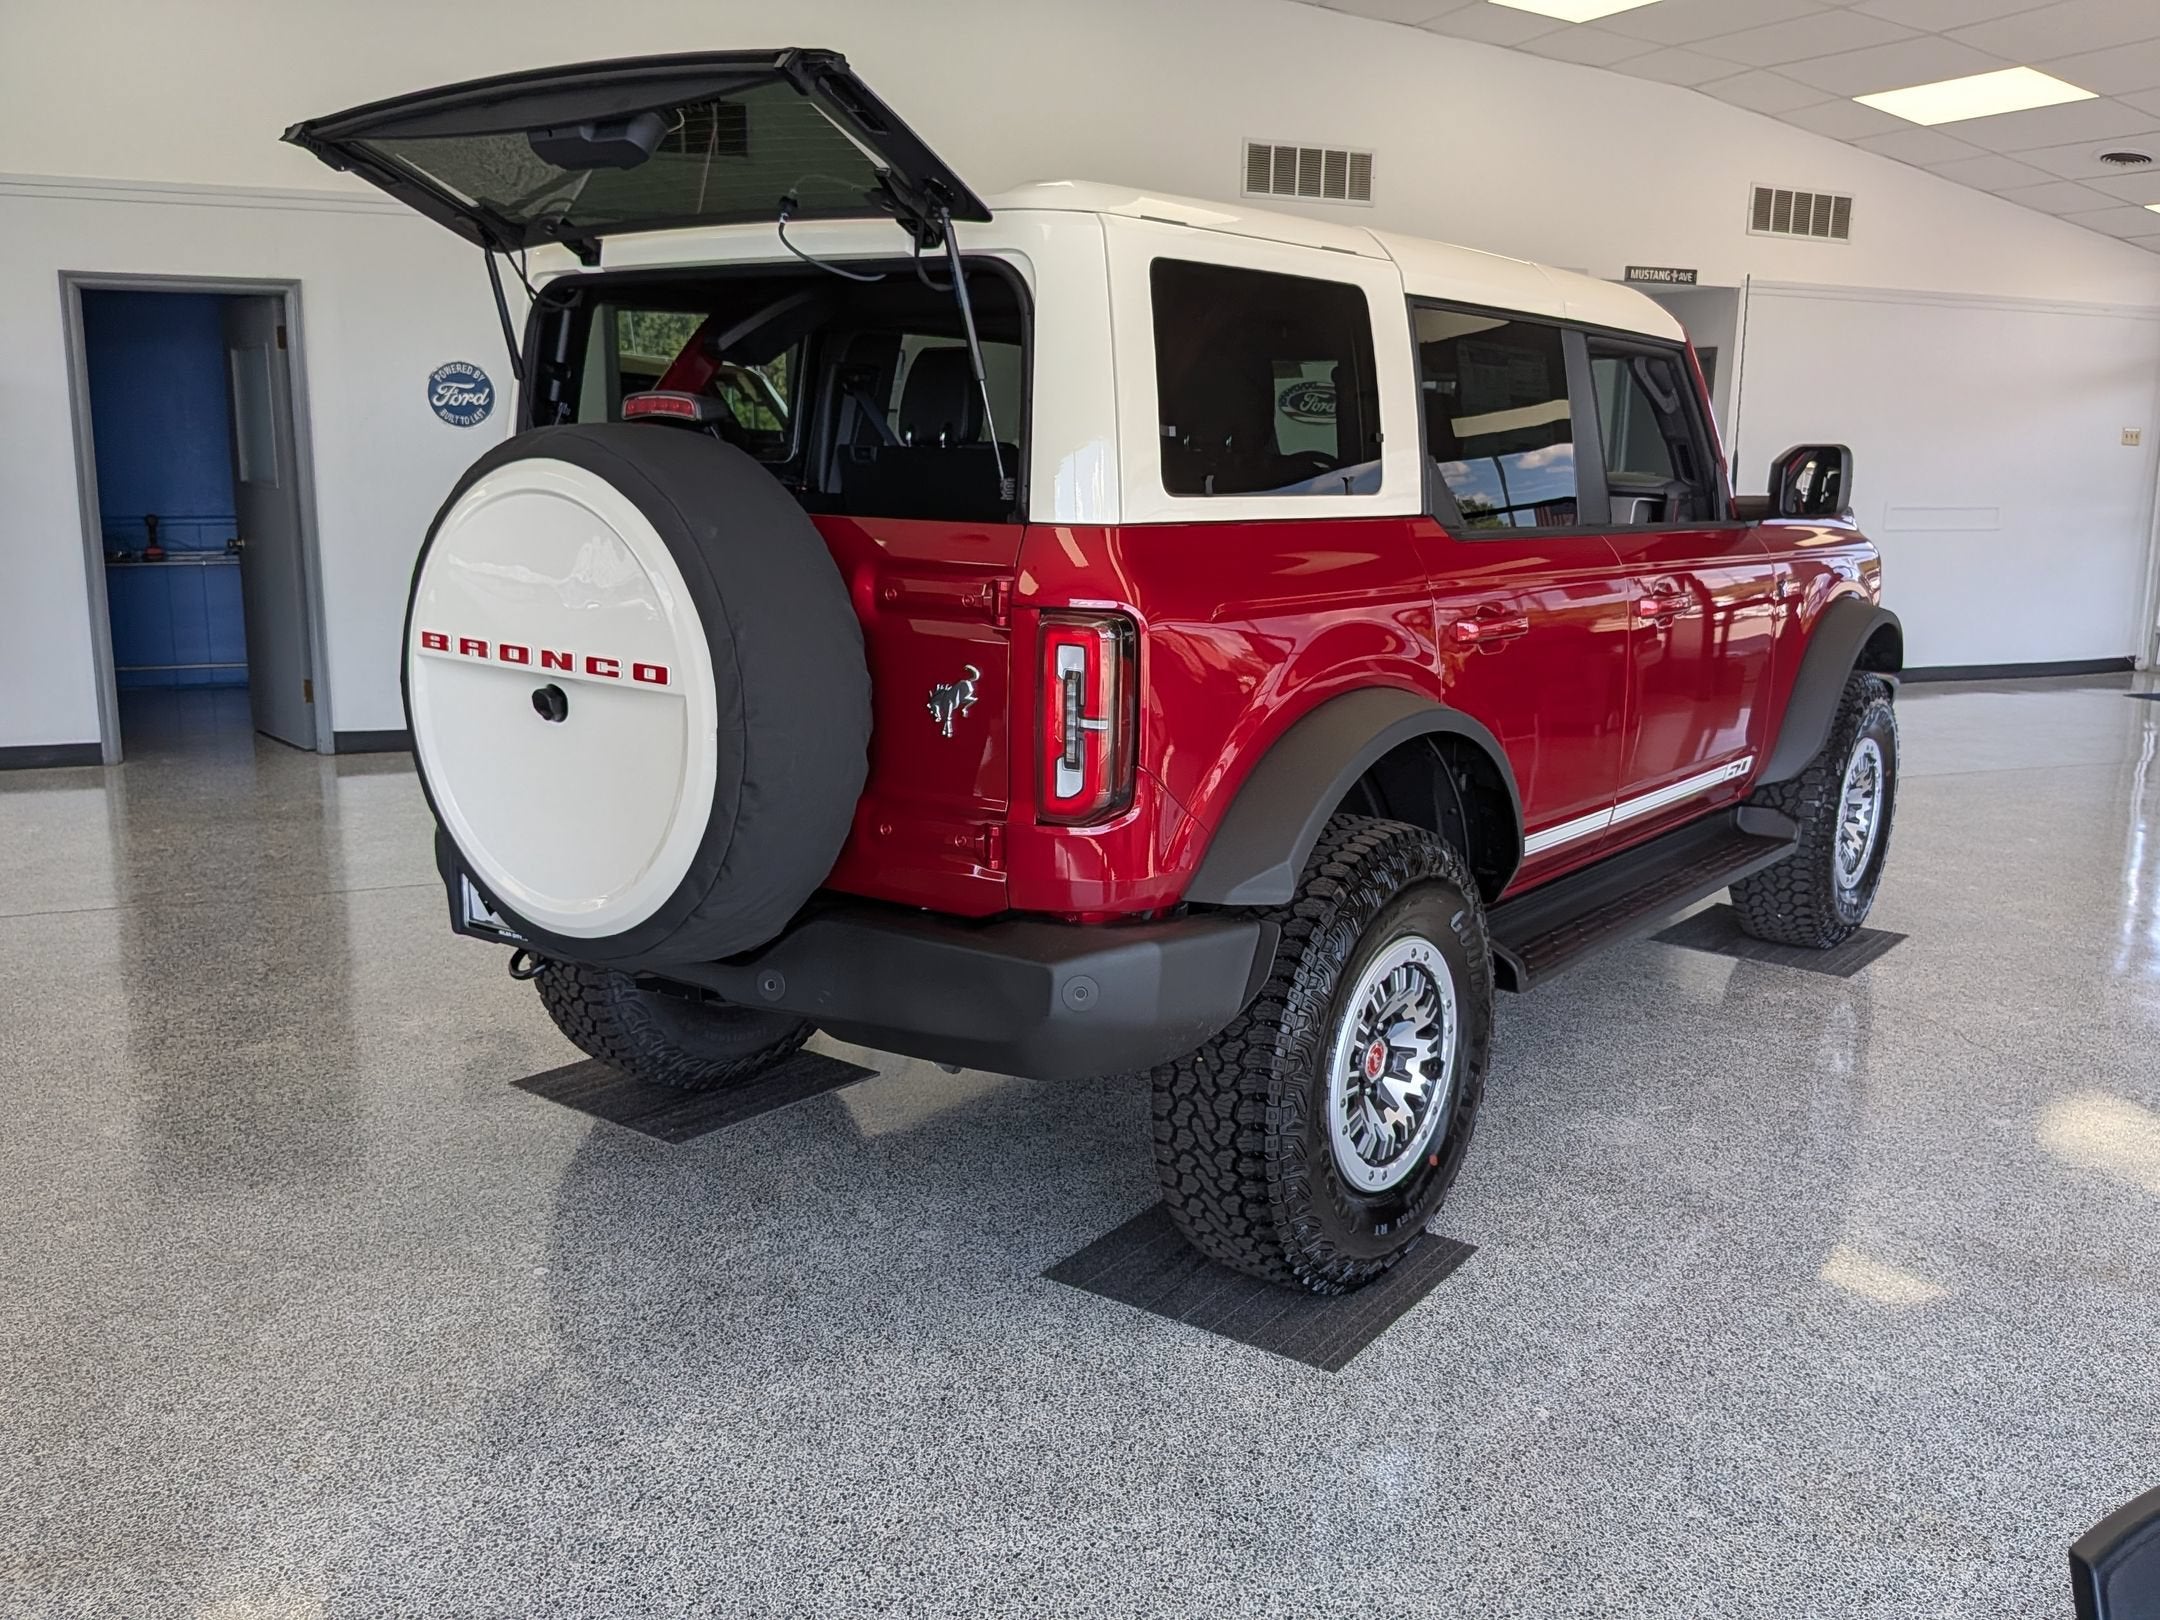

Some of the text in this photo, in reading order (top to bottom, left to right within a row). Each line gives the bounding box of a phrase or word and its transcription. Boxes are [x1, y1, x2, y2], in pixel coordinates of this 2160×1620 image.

[1630, 268, 1693, 282] MUSTANG AVE
[434, 363, 486, 382] POWERED BY
[432, 381, 489, 406] Ford
[440, 407, 486, 425] BUILT TO LAST
[421, 630, 671, 686] BRONCO
